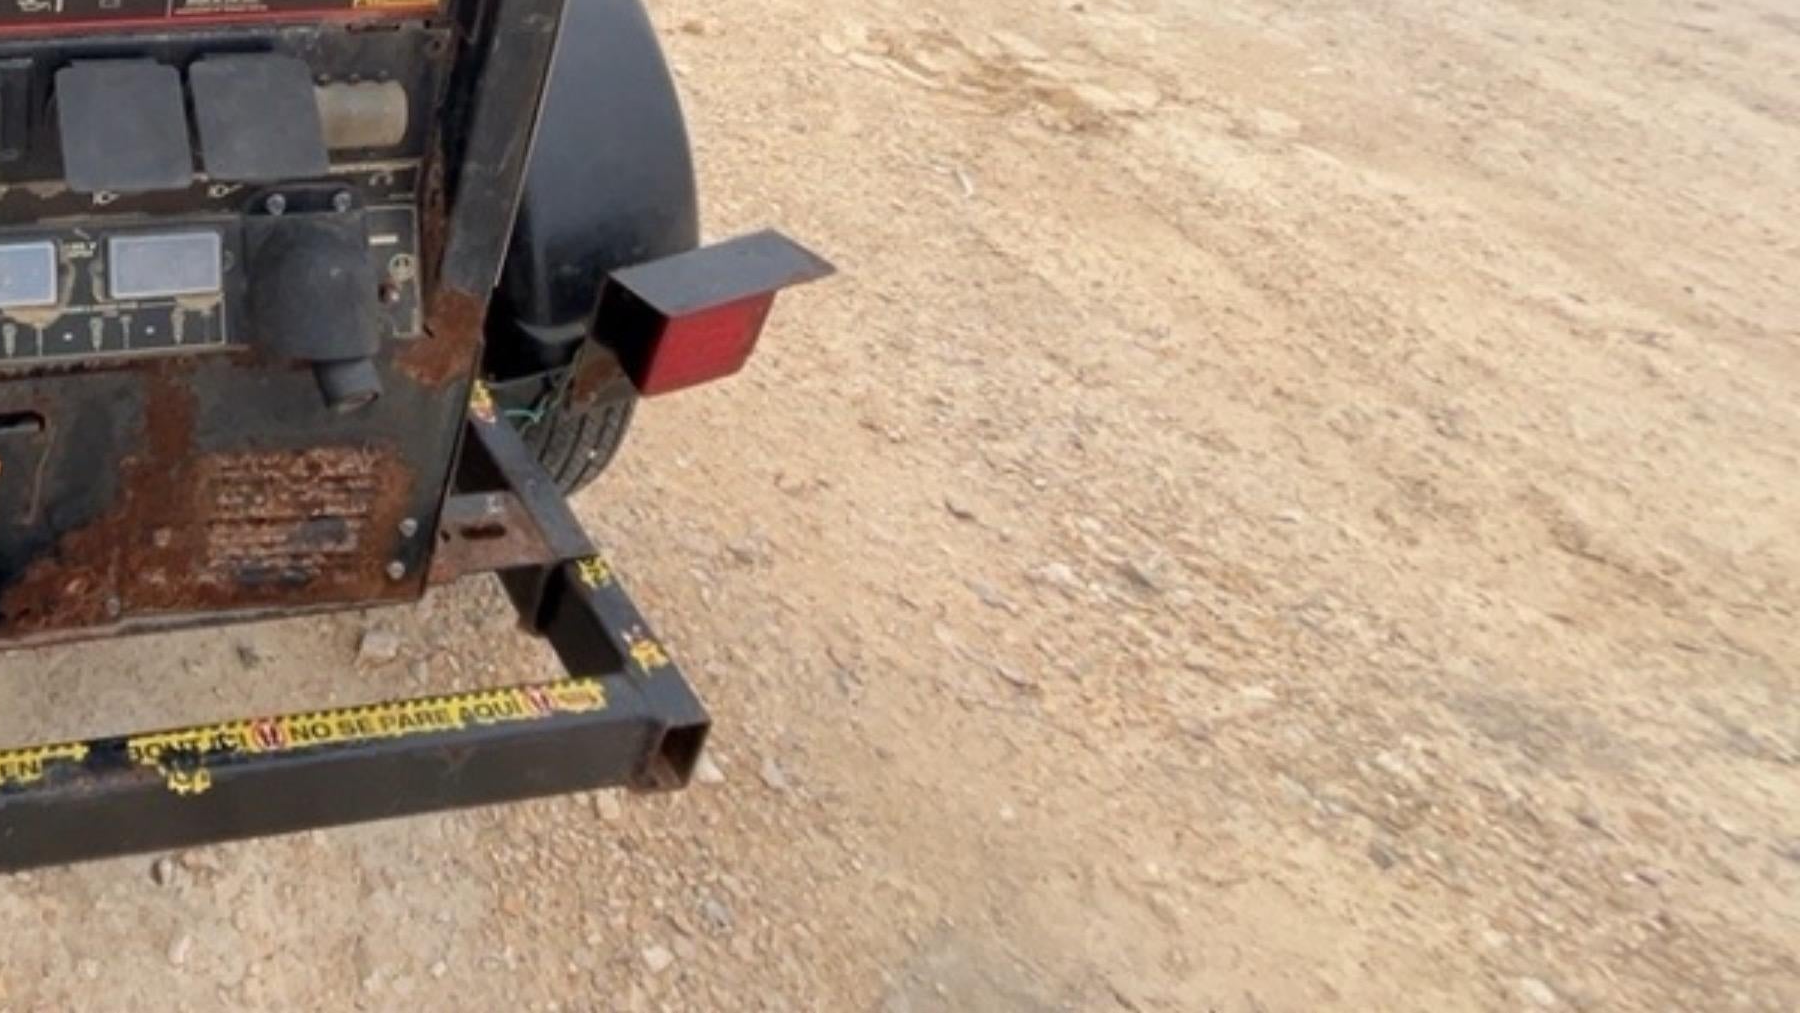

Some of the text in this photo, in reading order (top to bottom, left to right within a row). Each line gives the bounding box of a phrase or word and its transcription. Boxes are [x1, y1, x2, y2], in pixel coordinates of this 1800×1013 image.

[289, 721, 332, 741] NO
[338, 717, 374, 736] SE
[379, 707, 450, 731] PARE
